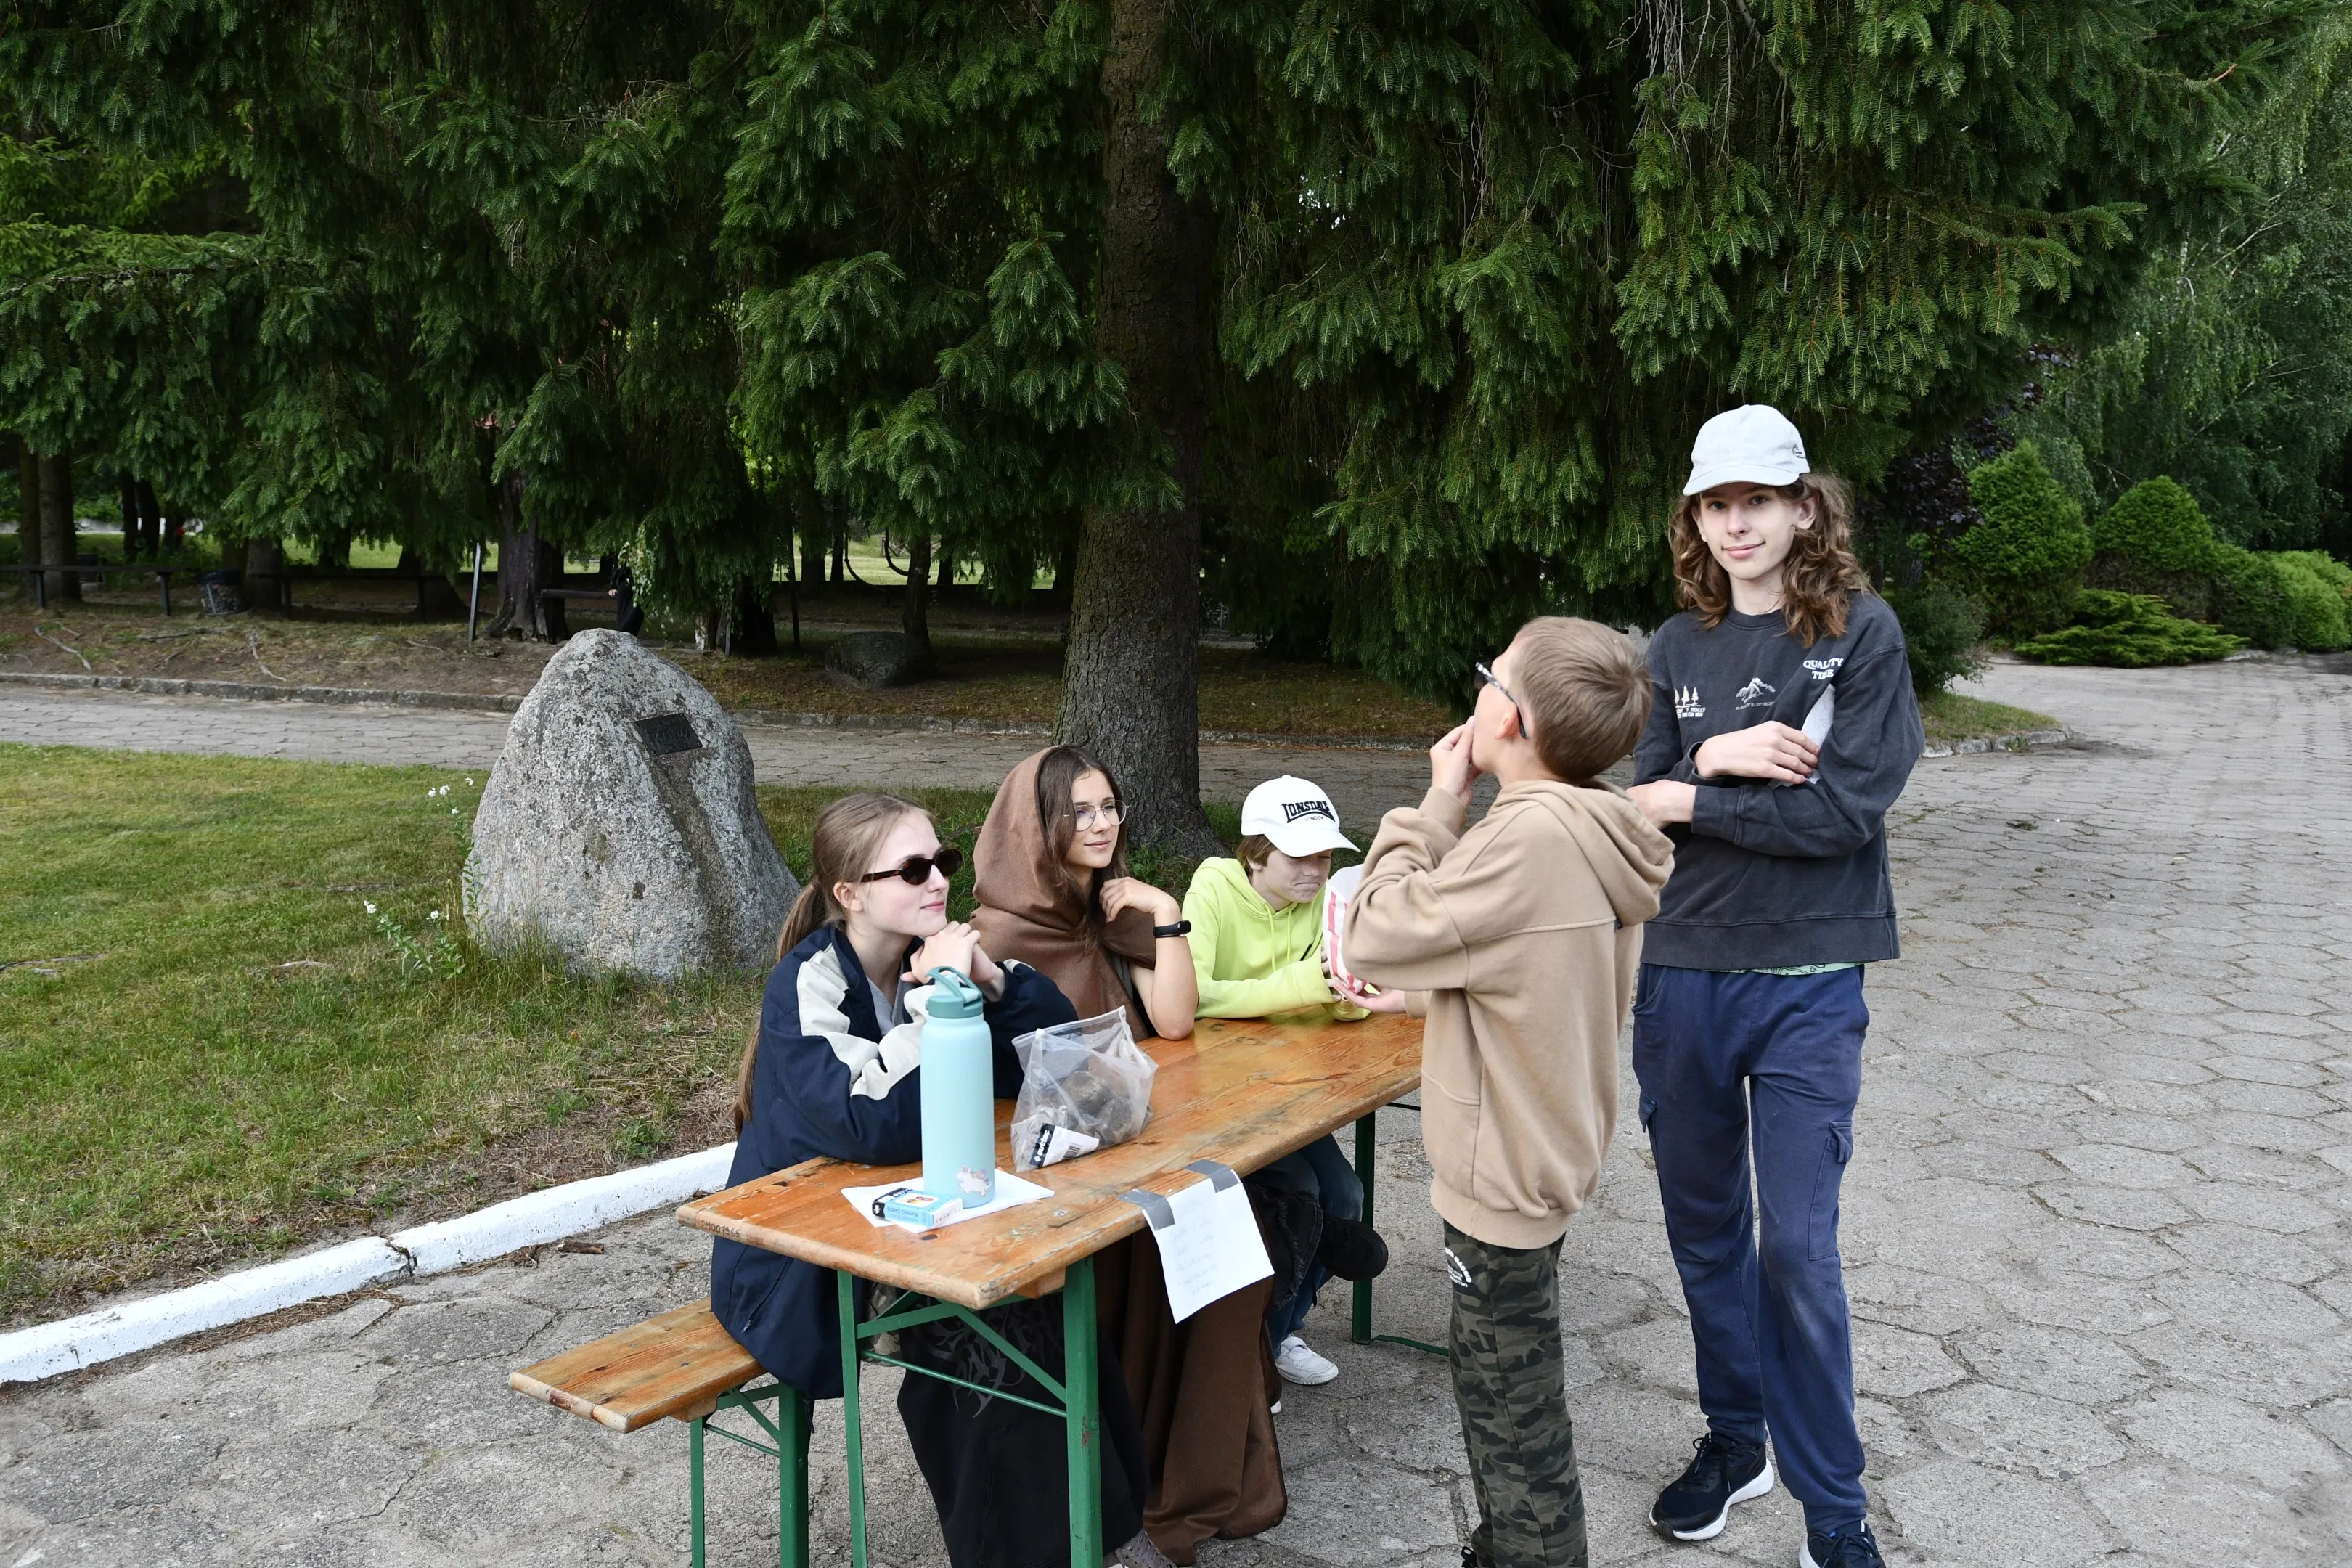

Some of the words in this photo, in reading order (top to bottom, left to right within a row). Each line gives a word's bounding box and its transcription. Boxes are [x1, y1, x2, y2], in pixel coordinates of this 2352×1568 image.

[1803, 658, 1844, 670] QUALITY
[1811, 669, 1834, 680] TIME
[1281, 801, 1335, 823] LONSDALE
